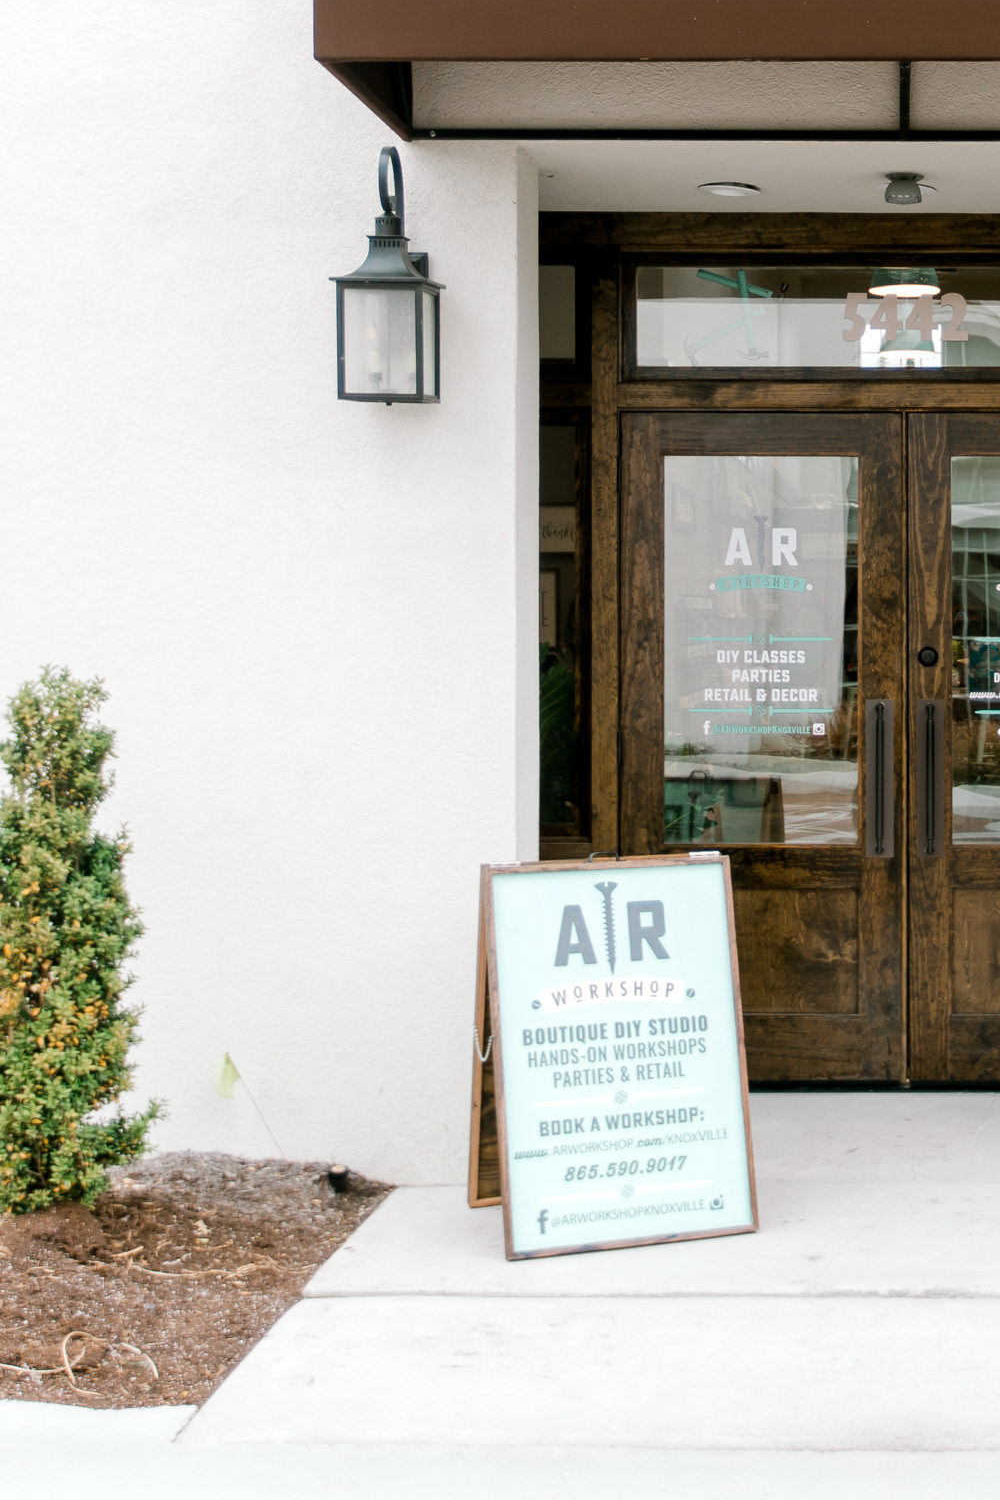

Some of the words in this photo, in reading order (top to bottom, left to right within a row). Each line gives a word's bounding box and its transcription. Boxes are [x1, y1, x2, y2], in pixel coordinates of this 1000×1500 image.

[842, 292, 969, 342] 5442
[725, 527, 799, 566] AR
[722, 576, 800, 589] WORKSHOP
[717, 650, 740, 664] DIY
[744, 650, 805, 664] CLASSES
[732, 669, 790, 683] PARTIES
[704, 688, 753, 702] RETAIL
[756, 688, 768, 702] &
[771, 688, 818, 702] DECOR
[554, 899, 671, 967] AR
[551, 980, 675, 1006] WORKSHOP
[522, 1023, 608, 1046] BOUTIQUE
[614, 1020, 641, 1039] DIY
[648, 1015, 709, 1036] STUDIO
[527, 1044, 608, 1069] HANDS-ON
[613, 1037, 707, 1061] WORKSHOPS
[553, 1067, 614, 1089] PARTIES
[620, 1065, 630, 1082] &
[636, 1061, 686, 1081] RETAIL
[539, 1117, 585, 1137] BOOK
[590, 1116, 601, 1132] A
[605, 1106, 705, 1130] WORKSHOP:
[514, 1127, 728, 1160] www.ARWORKSHOP.com/KNOXVILLE
[564, 1155, 687, 1182] 865.590.9017
[551, 1199, 705, 1227] @ARWORKSHOPKNOXVILLE
